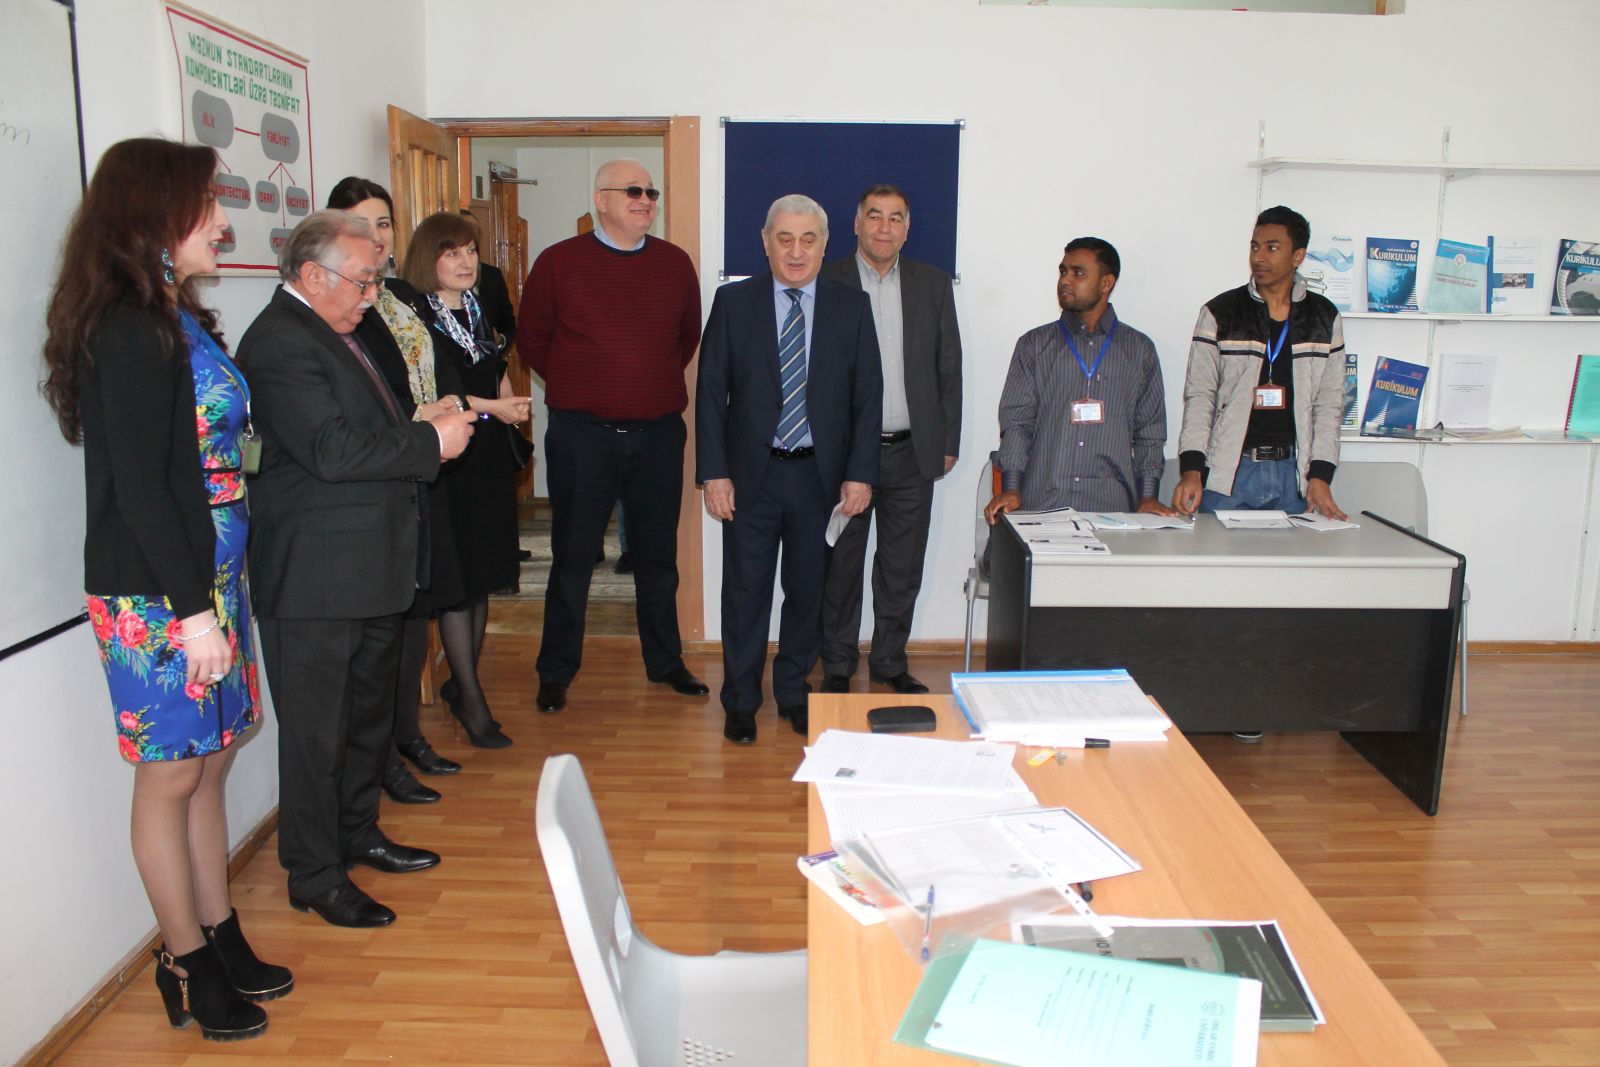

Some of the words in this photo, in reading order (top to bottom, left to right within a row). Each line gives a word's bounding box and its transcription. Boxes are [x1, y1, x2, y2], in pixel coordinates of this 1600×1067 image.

[1369, 247, 1417, 262] KURİKULUM
[1566, 254, 1600, 266] KURİKULU
[1375, 379, 1419, 397] KURİKULUM
